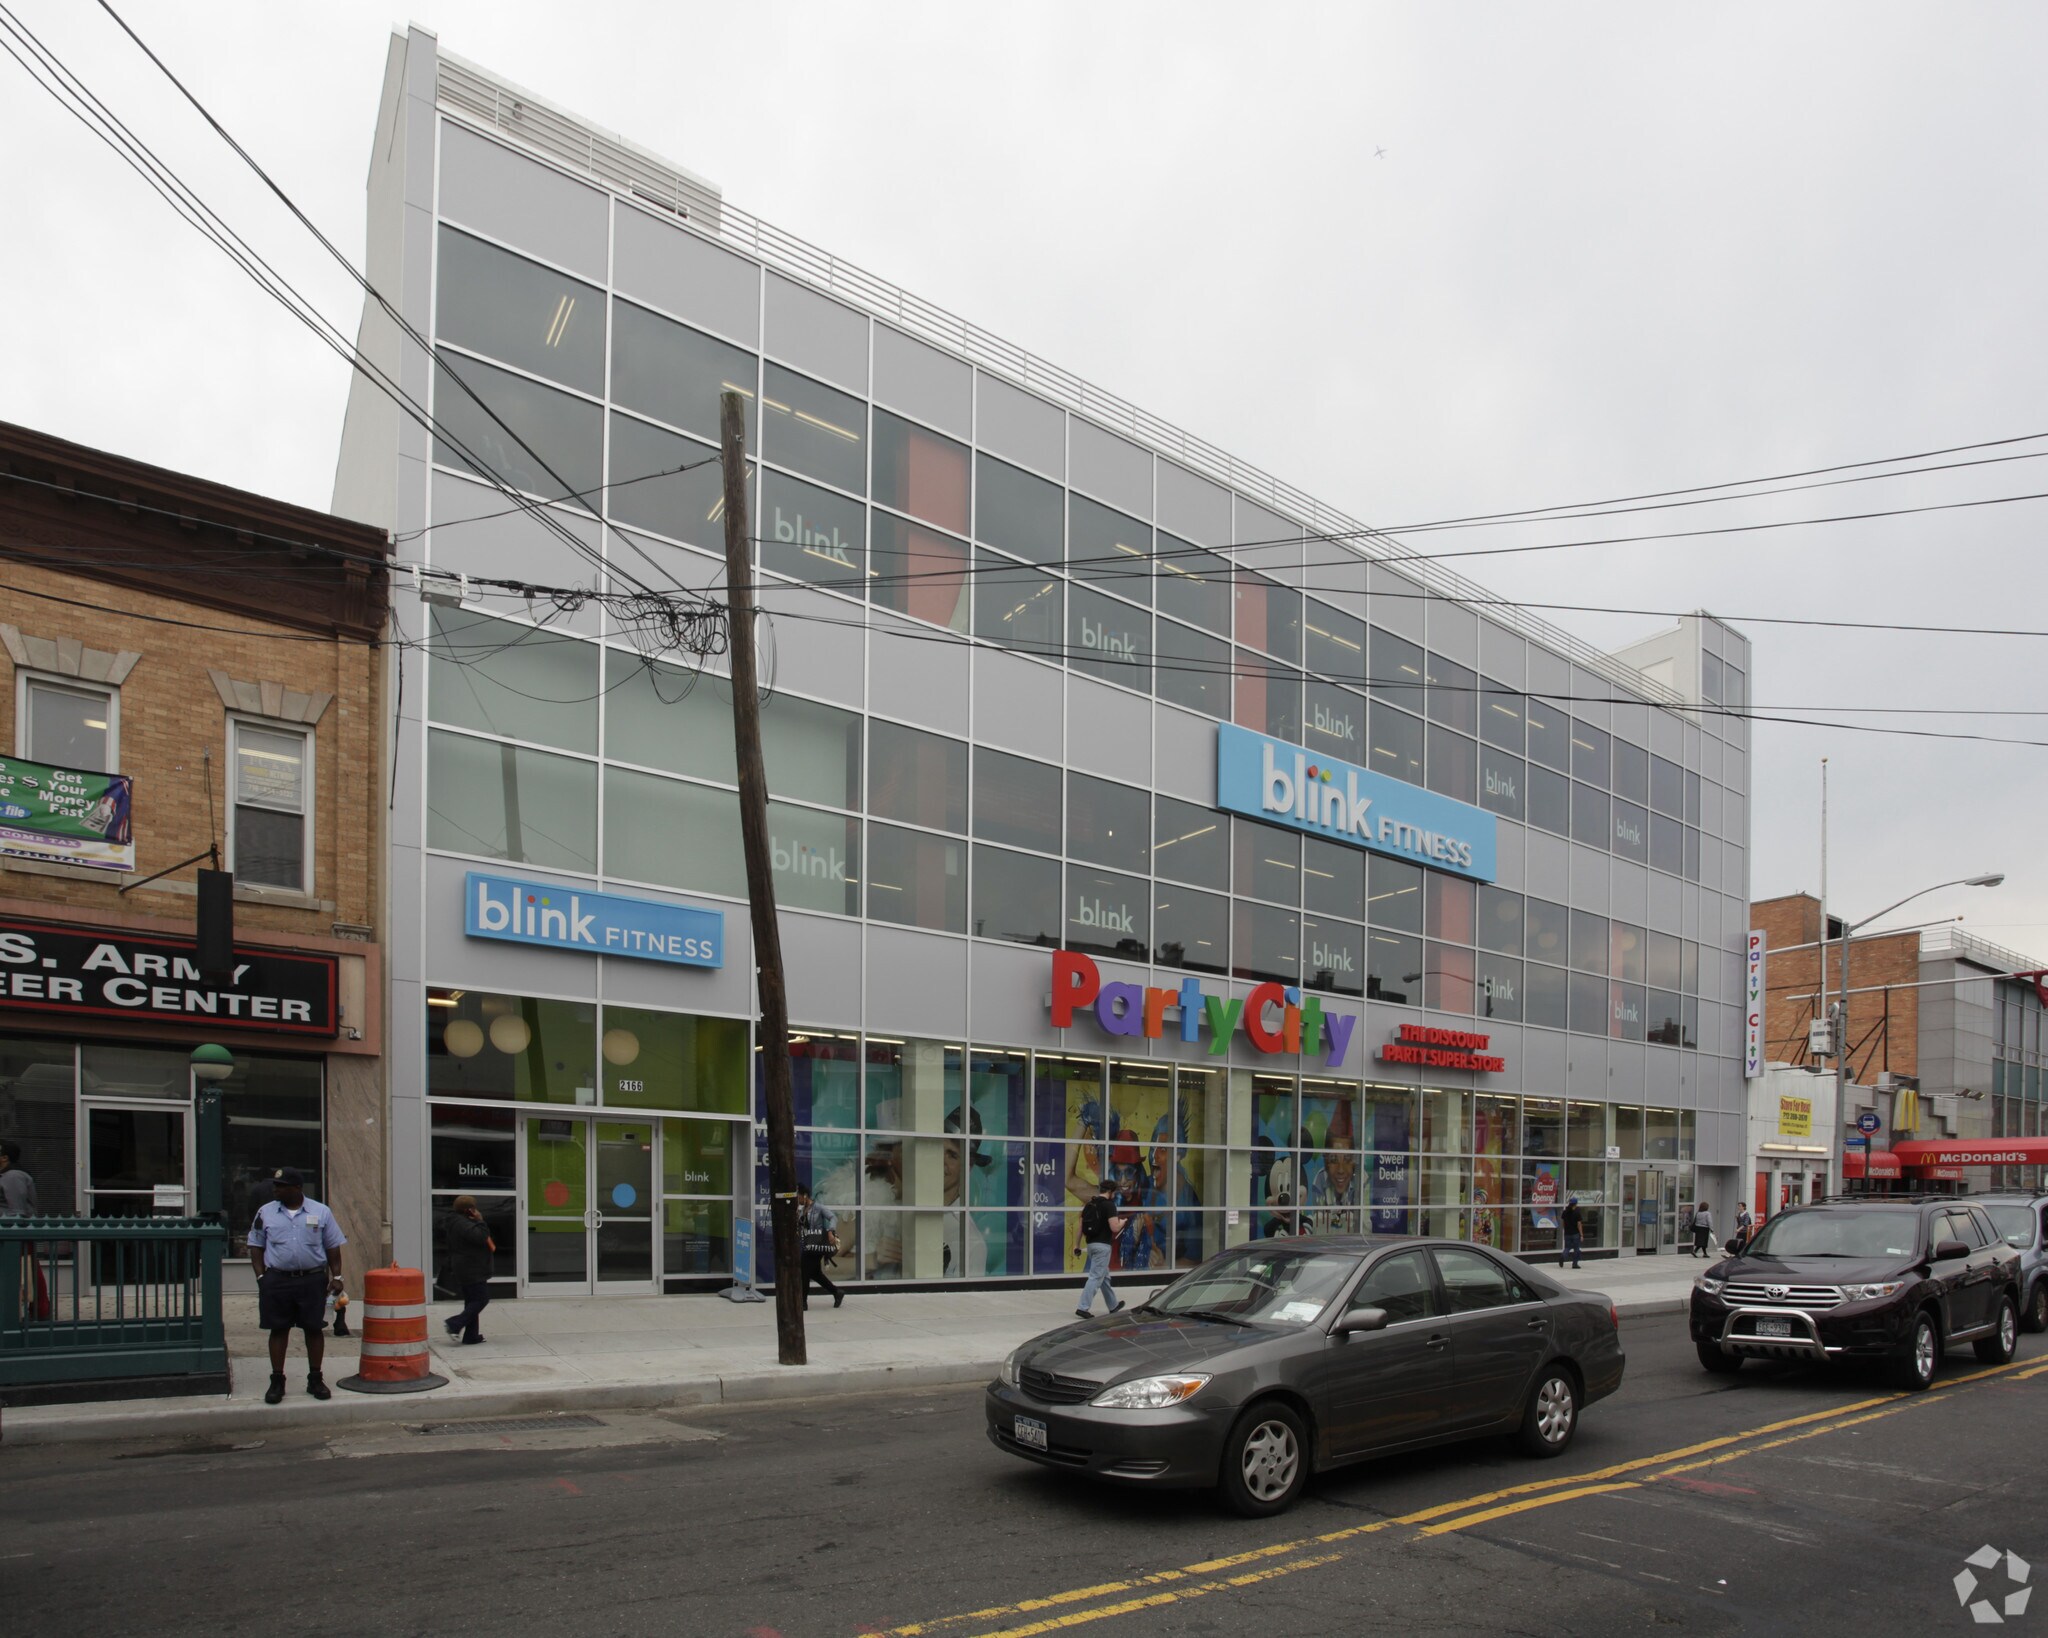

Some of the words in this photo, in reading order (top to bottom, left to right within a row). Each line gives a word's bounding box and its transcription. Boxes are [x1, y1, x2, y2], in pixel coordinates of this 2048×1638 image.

[774, 506, 850, 564] blink
[1081, 616, 1137, 664] blink
[1314, 703, 1354, 741] blink
[48, 780, 88, 796] Your
[53, 771, 83, 785] Get
[1485, 768, 1517, 801] blink
[39, 790, 96, 811] Money
[49, 803, 85, 818] Fast
[1262, 743, 1372, 840] blink
[1377, 815, 1472, 867] FITNESS
[49, 838, 78, 848] TAX
[1616, 817, 1641, 846] blink
[770, 836, 846, 881] blink
[478, 882, 598, 945] blink
[605, 927, 713, 960] FITNESS
[1079, 895, 1134, 934] blink
[1312, 943, 1354, 972] blink
[0, 972, 83, 1002] ER
[102, 977, 311, 1022] CENTER
[1483, 979, 1514, 1001] blink
[1614, 1000, 1639, 1024] blink
[1399, 1024, 1426, 1043] THE
[1425, 1027, 1490, 1051] DISCOUNT
[1382, 1044, 1427, 1065] PARTY
[1429, 1049, 1469, 1070] SUPER
[1469, 1053, 1505, 1073] STORE
[620, 1080, 643, 1092] 2166
[458, 1162, 489, 1177] blink
[1018, 1157, 1056, 1176] Sve!
[1939, 1152, 2028, 1163] McDonald's
[684, 1169, 710, 1183] blink
[1379, 1166, 1404, 1180] Deals!
[1537, 1180, 1554, 1192] Grand
